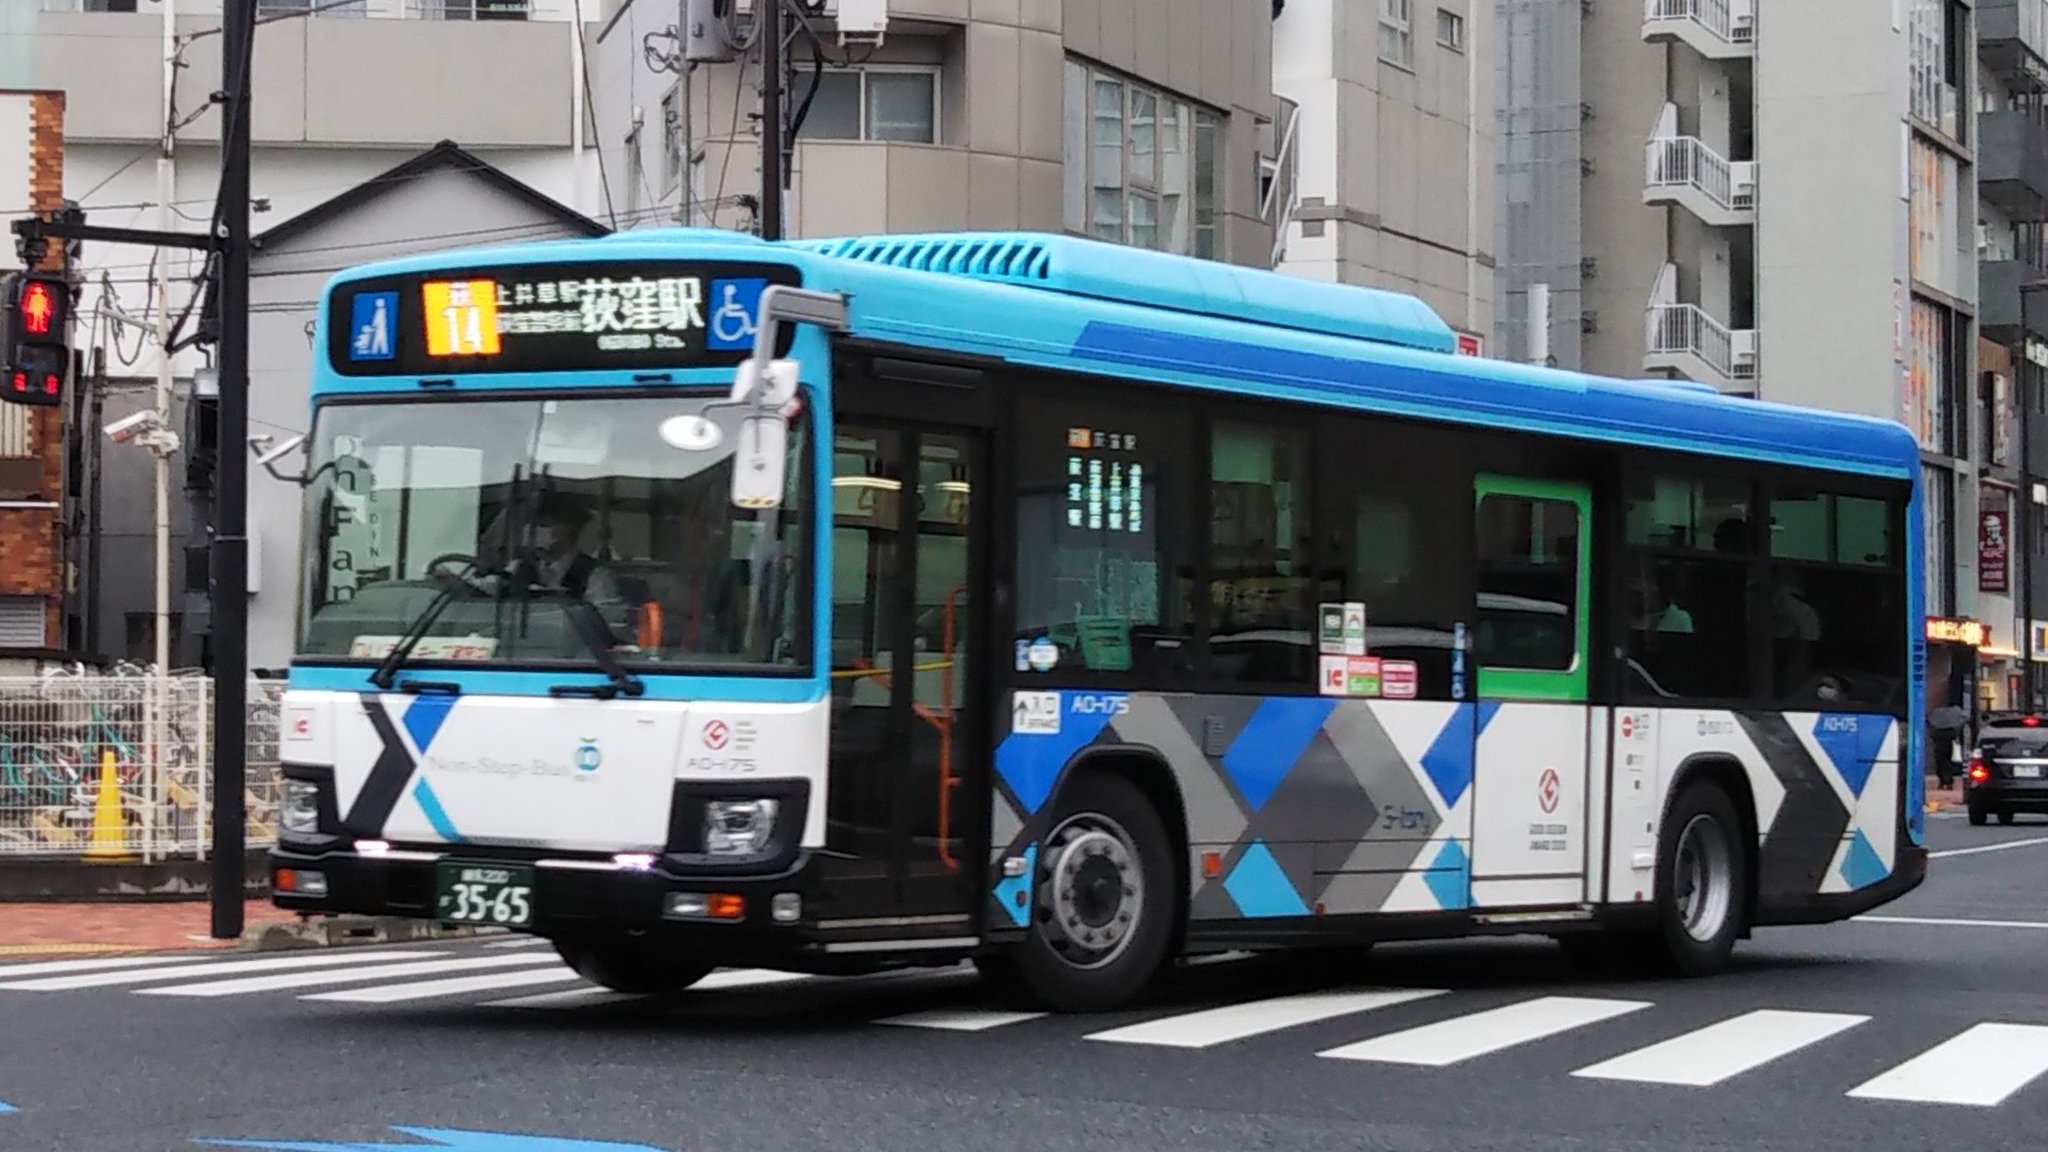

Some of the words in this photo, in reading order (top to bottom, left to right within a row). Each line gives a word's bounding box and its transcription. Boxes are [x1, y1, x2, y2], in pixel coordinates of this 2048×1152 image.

[581, 277, 704, 333] 荻窪駅
[442, 306, 483, 353] 14
[449, 883, 531, 924] 35-65
